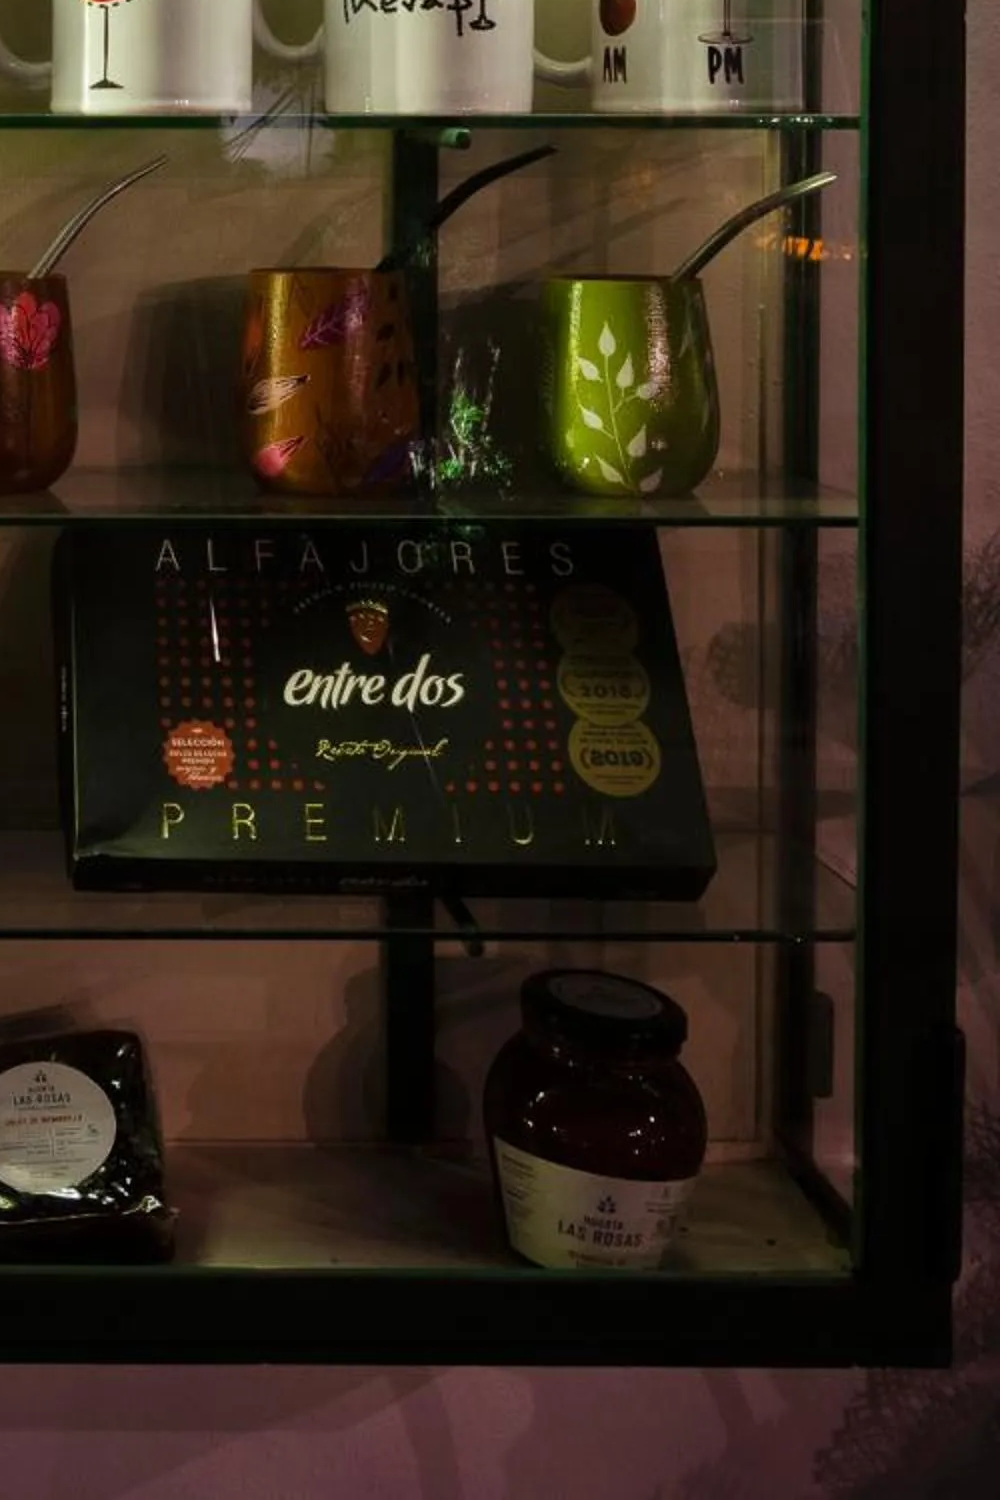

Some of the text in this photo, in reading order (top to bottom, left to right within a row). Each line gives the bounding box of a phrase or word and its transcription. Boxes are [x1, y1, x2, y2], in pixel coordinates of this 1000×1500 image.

[602, 45, 628, 84] AM
[706, 45, 745, 85] PM
[154, 538, 575, 577] ALFAJORES
[282, 653, 466, 713] entre dos
[160, 802, 617, 846] PREMIUM
[557, 1219, 644, 1247] LAS ROSAS
